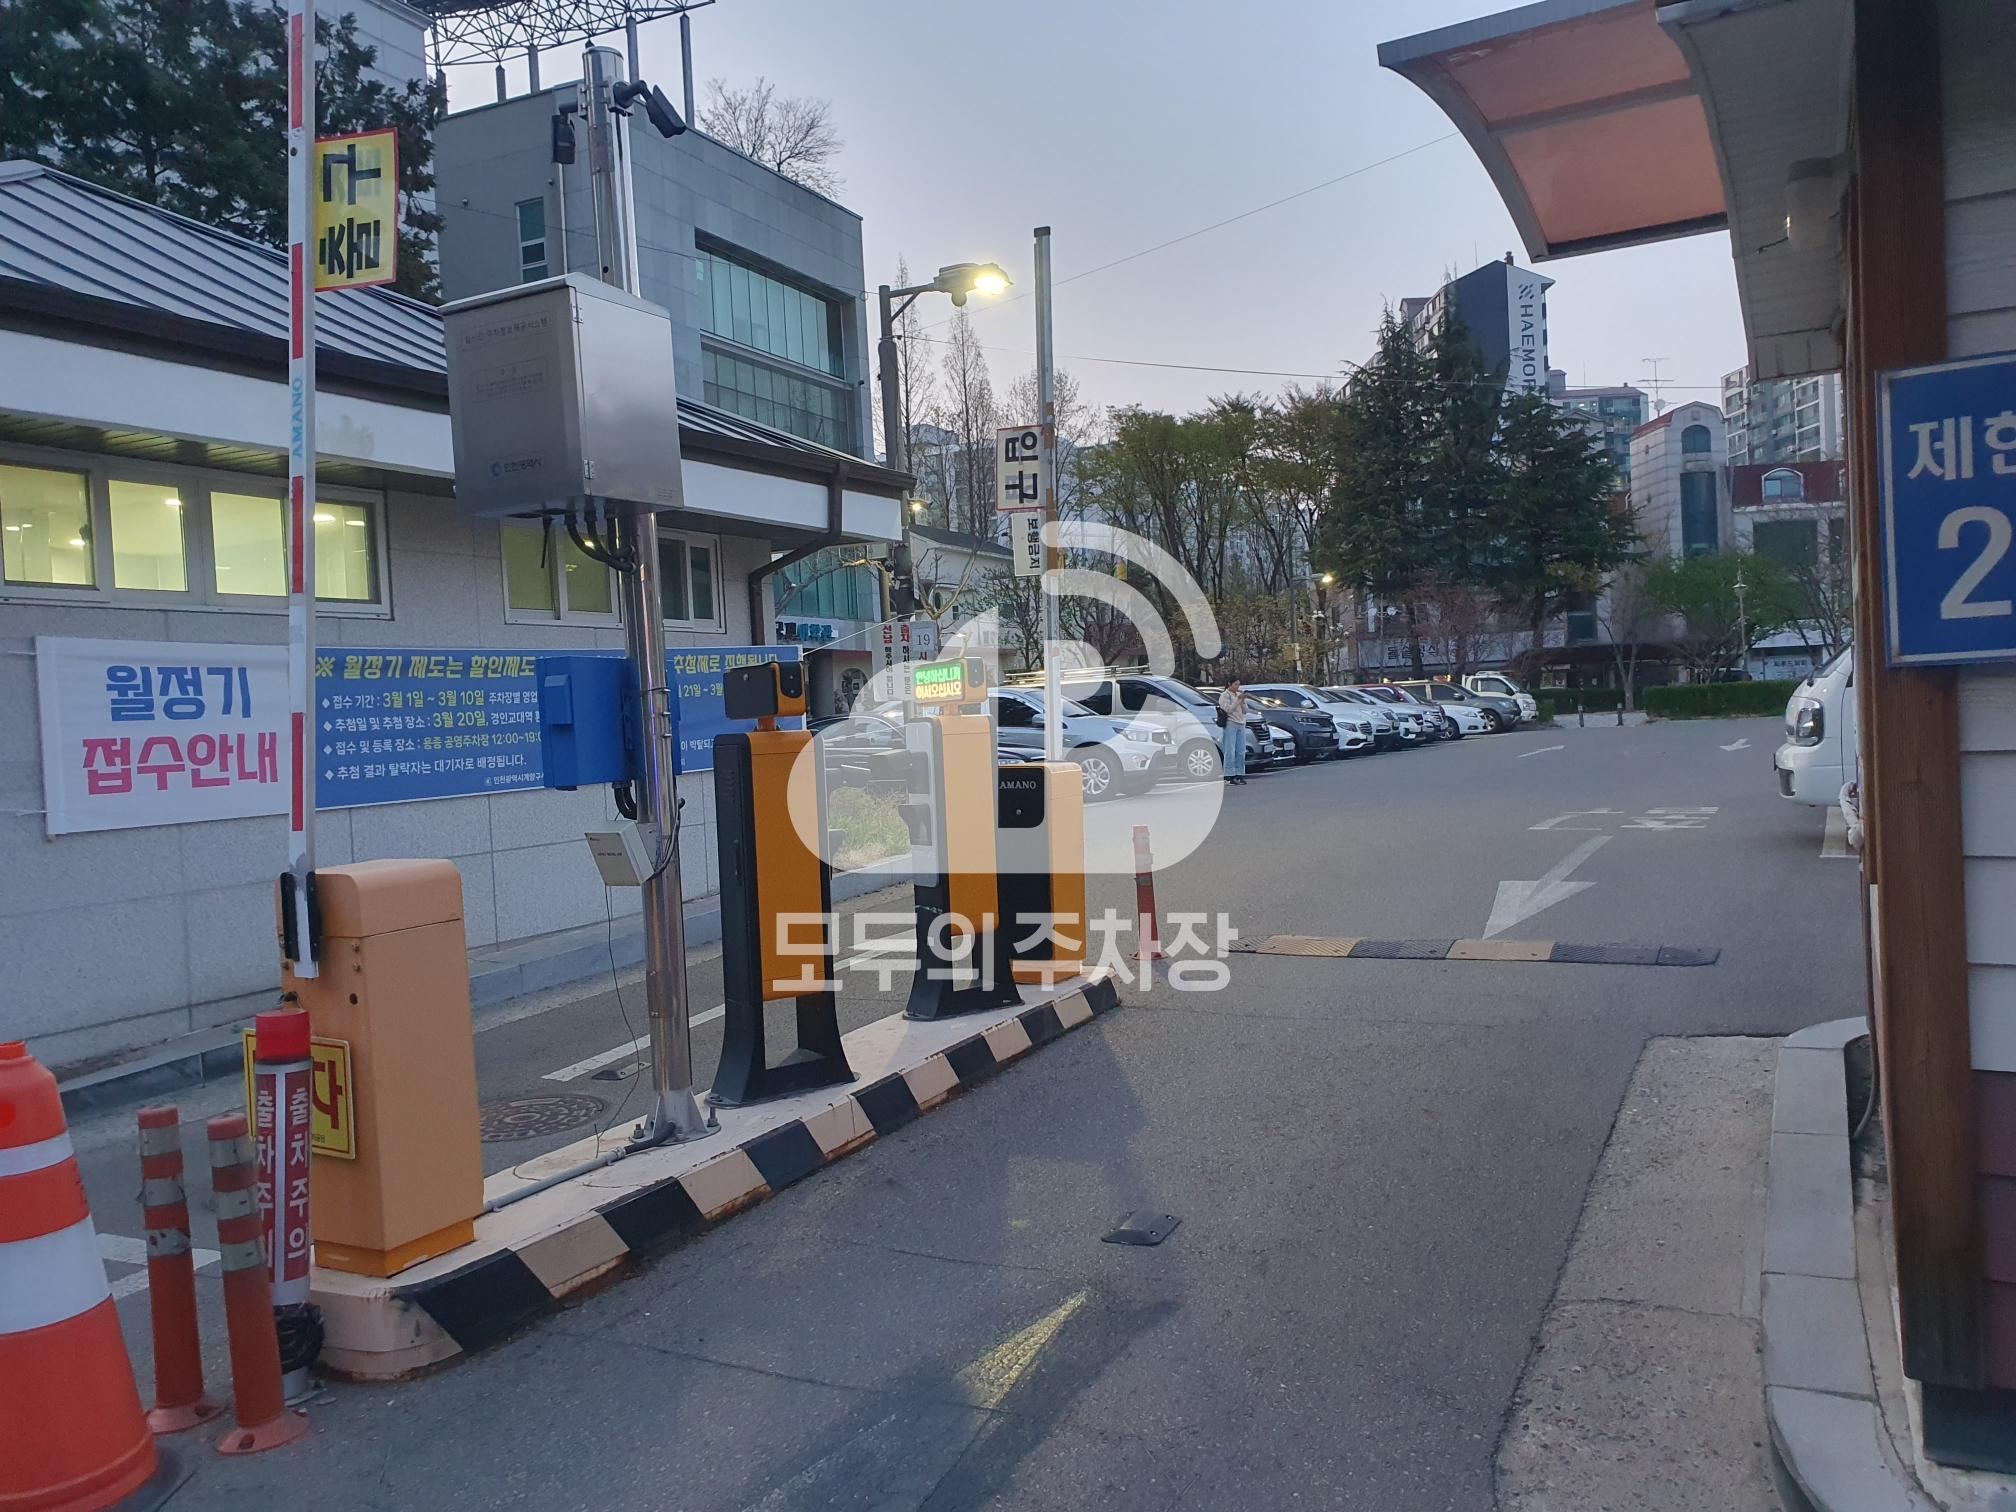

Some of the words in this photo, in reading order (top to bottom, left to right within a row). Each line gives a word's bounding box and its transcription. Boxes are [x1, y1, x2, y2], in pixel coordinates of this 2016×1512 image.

[319, 143, 381, 279] 출구
[291, 377, 304, 458] AMANO
[1004, 431, 1039, 504] 입구
[1027, 518, 1041, 569] 보행금지
[917, 633, 931, 646] 19
[343, 655, 402, 680] 월정기
[105, 665, 252, 722] 월정기
[332, 695, 353, 710] 접수
[382, 690, 403, 709] 3월
[406, 690, 424, 708] 1일
[438, 690, 457, 707] 3월
[460, 689, 484, 706] 10일
[488, 691, 521, 705] 주차장별
[335, 717, 367, 732] 추첨일
[369, 717, 380, 730] 및
[382, 716, 403, 730] 추첨
[433, 711, 454, 728] 3월
[490, 711, 533, 726] 경인교대역
[335, 741, 357, 755] 접수
[359, 739, 370, 754] 및
[372, 738, 393, 753] 등록
[444, 734, 489, 748] 공영주차장
[82, 731, 279, 796] 접수안내
[337, 765, 360, 780] 추첨
[363, 763, 386, 778] 결과
[388, 760, 432, 776] 탈락자는
[434, 758, 474, 773] 대기자로
[999, 780, 1037, 790] AMANO
